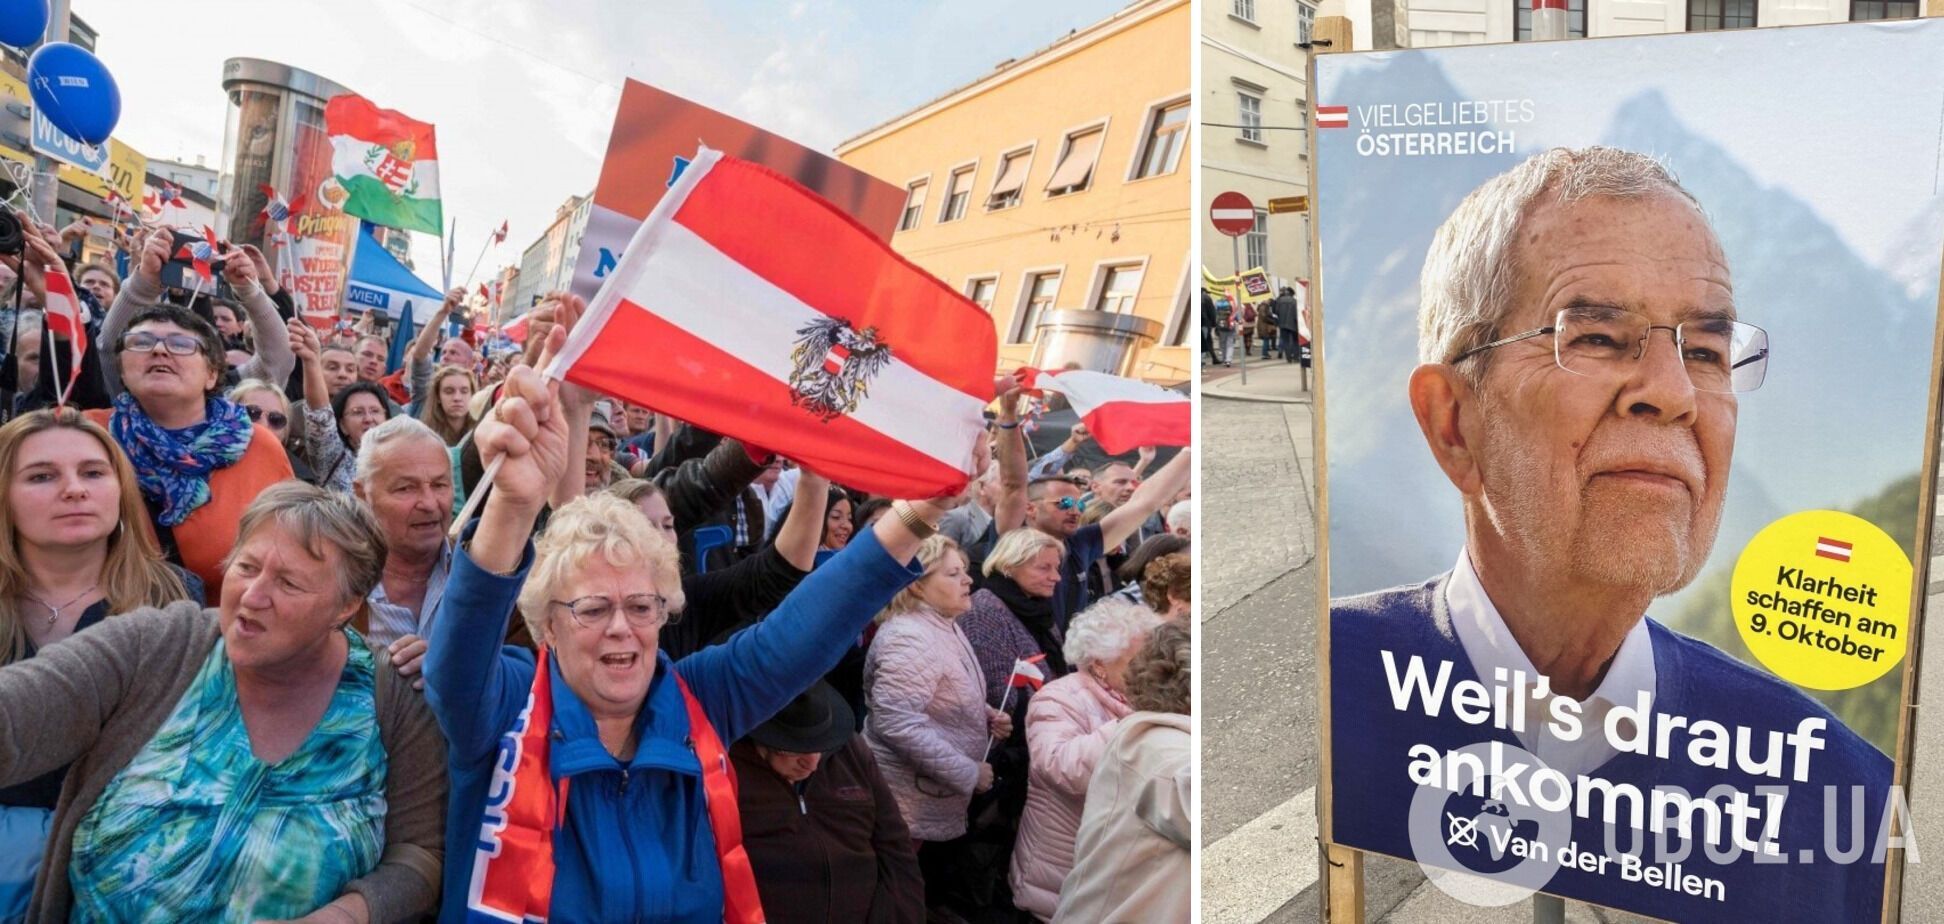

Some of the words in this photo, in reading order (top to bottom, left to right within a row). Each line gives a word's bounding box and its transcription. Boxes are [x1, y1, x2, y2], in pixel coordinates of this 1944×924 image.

[1357, 99, 1535, 127] VIELGELIEBTES
[1356, 129, 1515, 156] ÖSTERREICH
[349, 287, 384, 305] WIEN
[1777, 565, 1877, 607] Klarheit
[1747, 590, 1852, 629] schaffen
[1857, 616, 1897, 639] am
[1750, 613, 1772, 636] 9.
[1778, 620, 1884, 662] Oktober
[1604, 690, 1826, 782] drauf
[1408, 740, 1784, 856] ankommt!
[1490, 824, 1548, 862] Van
[1557, 842, 1612, 875] der
[1621, 853, 1725, 901] Bellen
